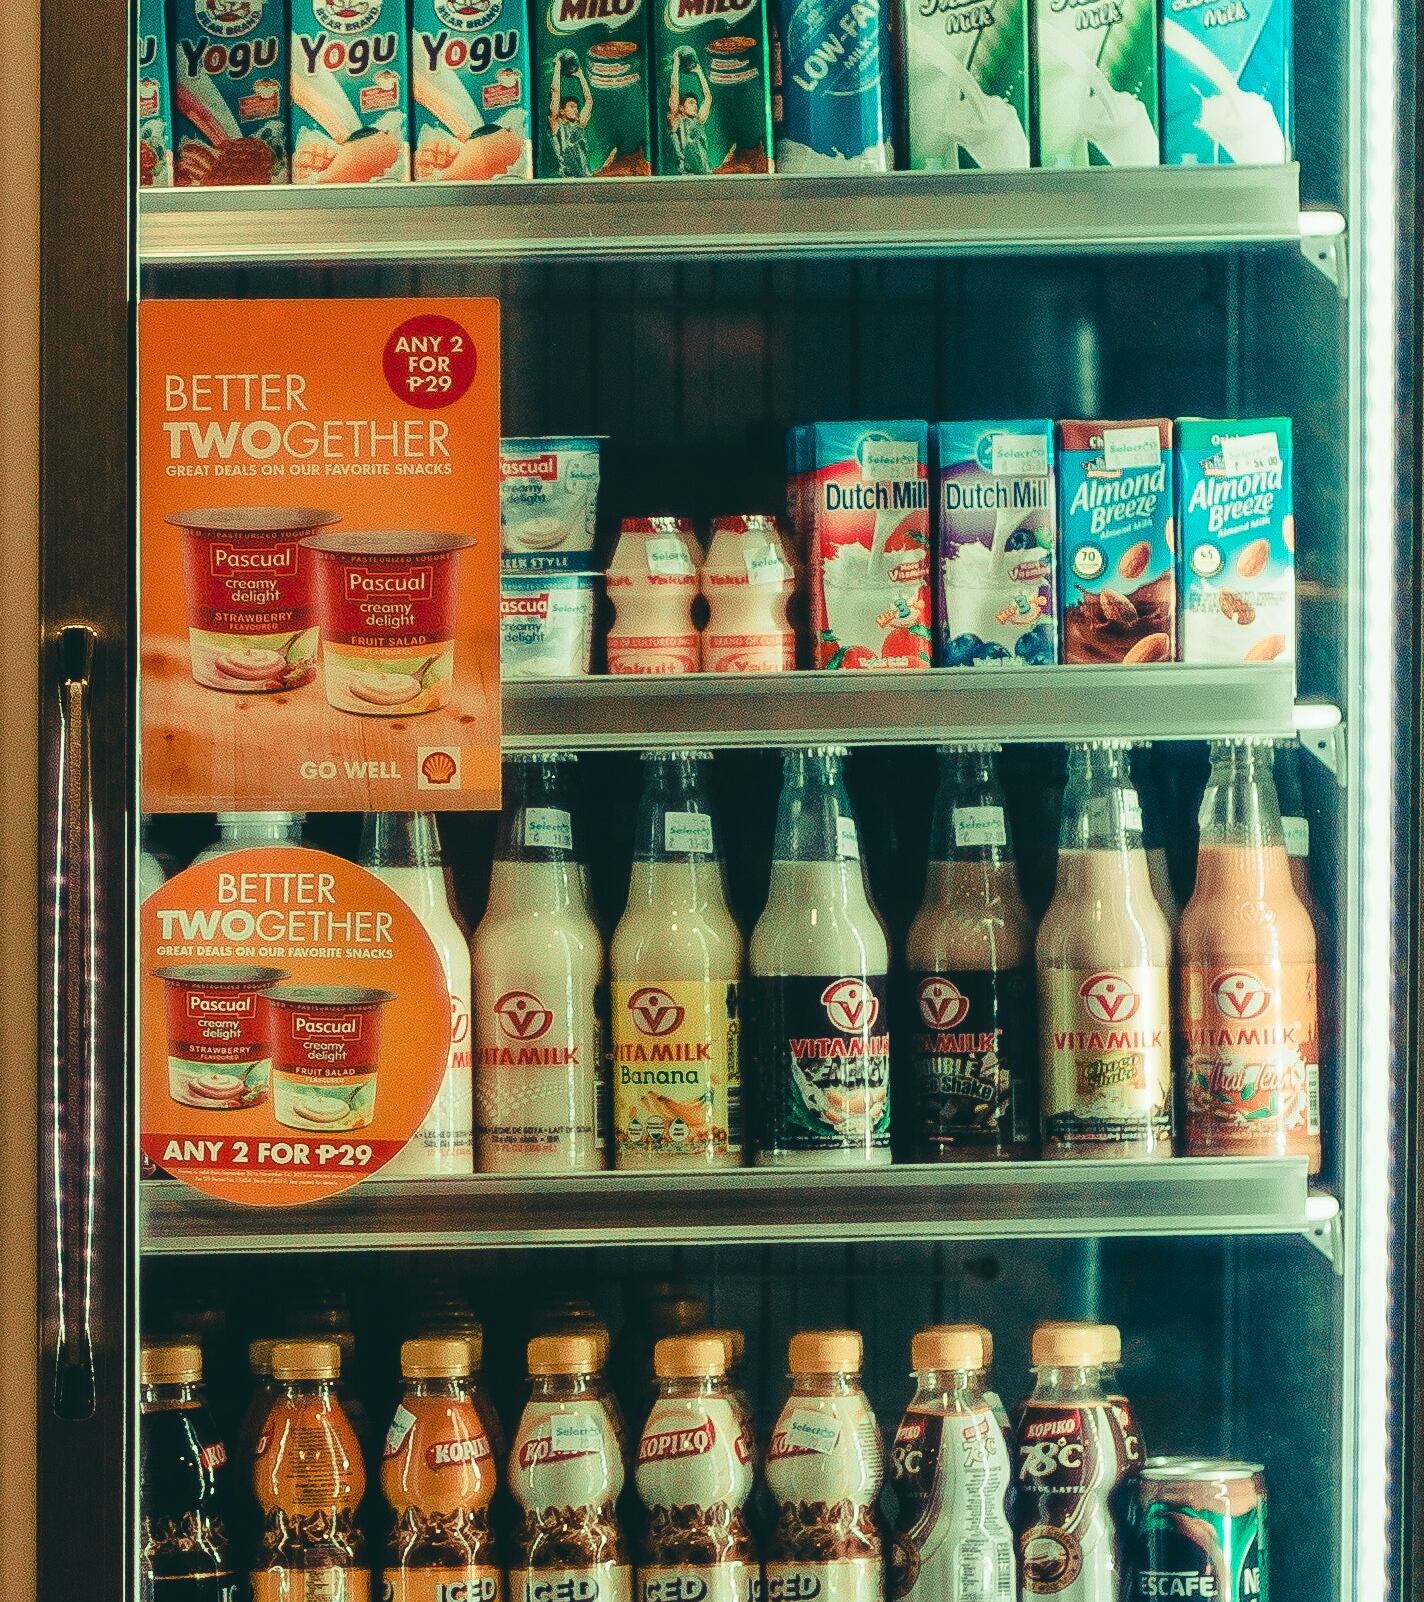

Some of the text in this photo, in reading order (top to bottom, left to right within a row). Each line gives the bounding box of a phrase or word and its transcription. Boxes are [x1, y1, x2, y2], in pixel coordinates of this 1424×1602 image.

[317, 8, 378, 32] BEAR BRAND
[466, 6, 500, 31] BRAND
[560, 0, 636, 22] MILO
[945, 6, 995, 35] Milk
[1076, 5, 1123, 31] Milk
[1204, 2, 1249, 28] Milk
[196, 11, 261, 36] BEAR BRAND
[181, 36, 277, 79] Yogu
[300, 33, 396, 74] Yogu
[420, 31, 520, 72] Yogu
[394, 335, 464, 353] ANY 2
[408, 355, 451, 373] FOR
[164, 373, 309, 412] BETTER
[162, 419, 451, 460] TWOGETHER
[165, 463, 453, 477] GREAT DEALS ON OUR FAVORITE SNACKS
[502, 459, 554, 476] ascual
[826, 480, 928, 510] Dutch Mill
[946, 480, 1048, 510] Dutch Mill
[1069, 463, 1166, 516] Almond
[1188, 460, 1283, 513] Almond
[1090, 494, 1157, 534] Breeze
[1207, 493, 1274, 532] Breeze
[215, 548, 291, 567] Pascual
[225, 580, 277, 594] creamy
[349, 573, 426, 591] Pascual
[231, 588, 281, 605] delight
[501, 598, 548, 613] ascua
[214, 611, 293, 623] STRAWBERRY
[359, 603, 412, 617] creamy
[365, 612, 416, 629] delight
[351, 635, 427, 646] FRUIT SALAD
[299, 761, 401, 780] GO WELL
[217, 872, 336, 904] BETTER
[156, 909, 394, 944] TWOGETHER
[156, 946, 394, 960] GREAT DEALS ON OUR FAVORITE SNACKS
[190, 996, 251, 1013] Pascual
[197, 1020, 240, 1033] creamy
[202, 1027, 242, 1040] delight
[295, 1017, 356, 1034] Pascual
[1052, 1030, 1163, 1050] VITAMILK
[1190, 1027, 1295, 1046] VITAMILK
[189, 1045, 251, 1054] STRAWBERRY
[303, 1041, 345, 1054] creamy
[307, 1049, 347, 1063] delight
[613, 1043, 712, 1062] ITAMILK
[295, 1067, 356, 1077] FRUIT SALAD
[621, 1065, 700, 1086] Banana
[162, 1140, 224, 1162] ANY
[231, 1141, 249, 1163] 2
[258, 1142, 311, 1165] FOR
[1026, 1419, 1077, 1438] KOPIKO
[639, 1429, 708, 1460] KOPIKO
